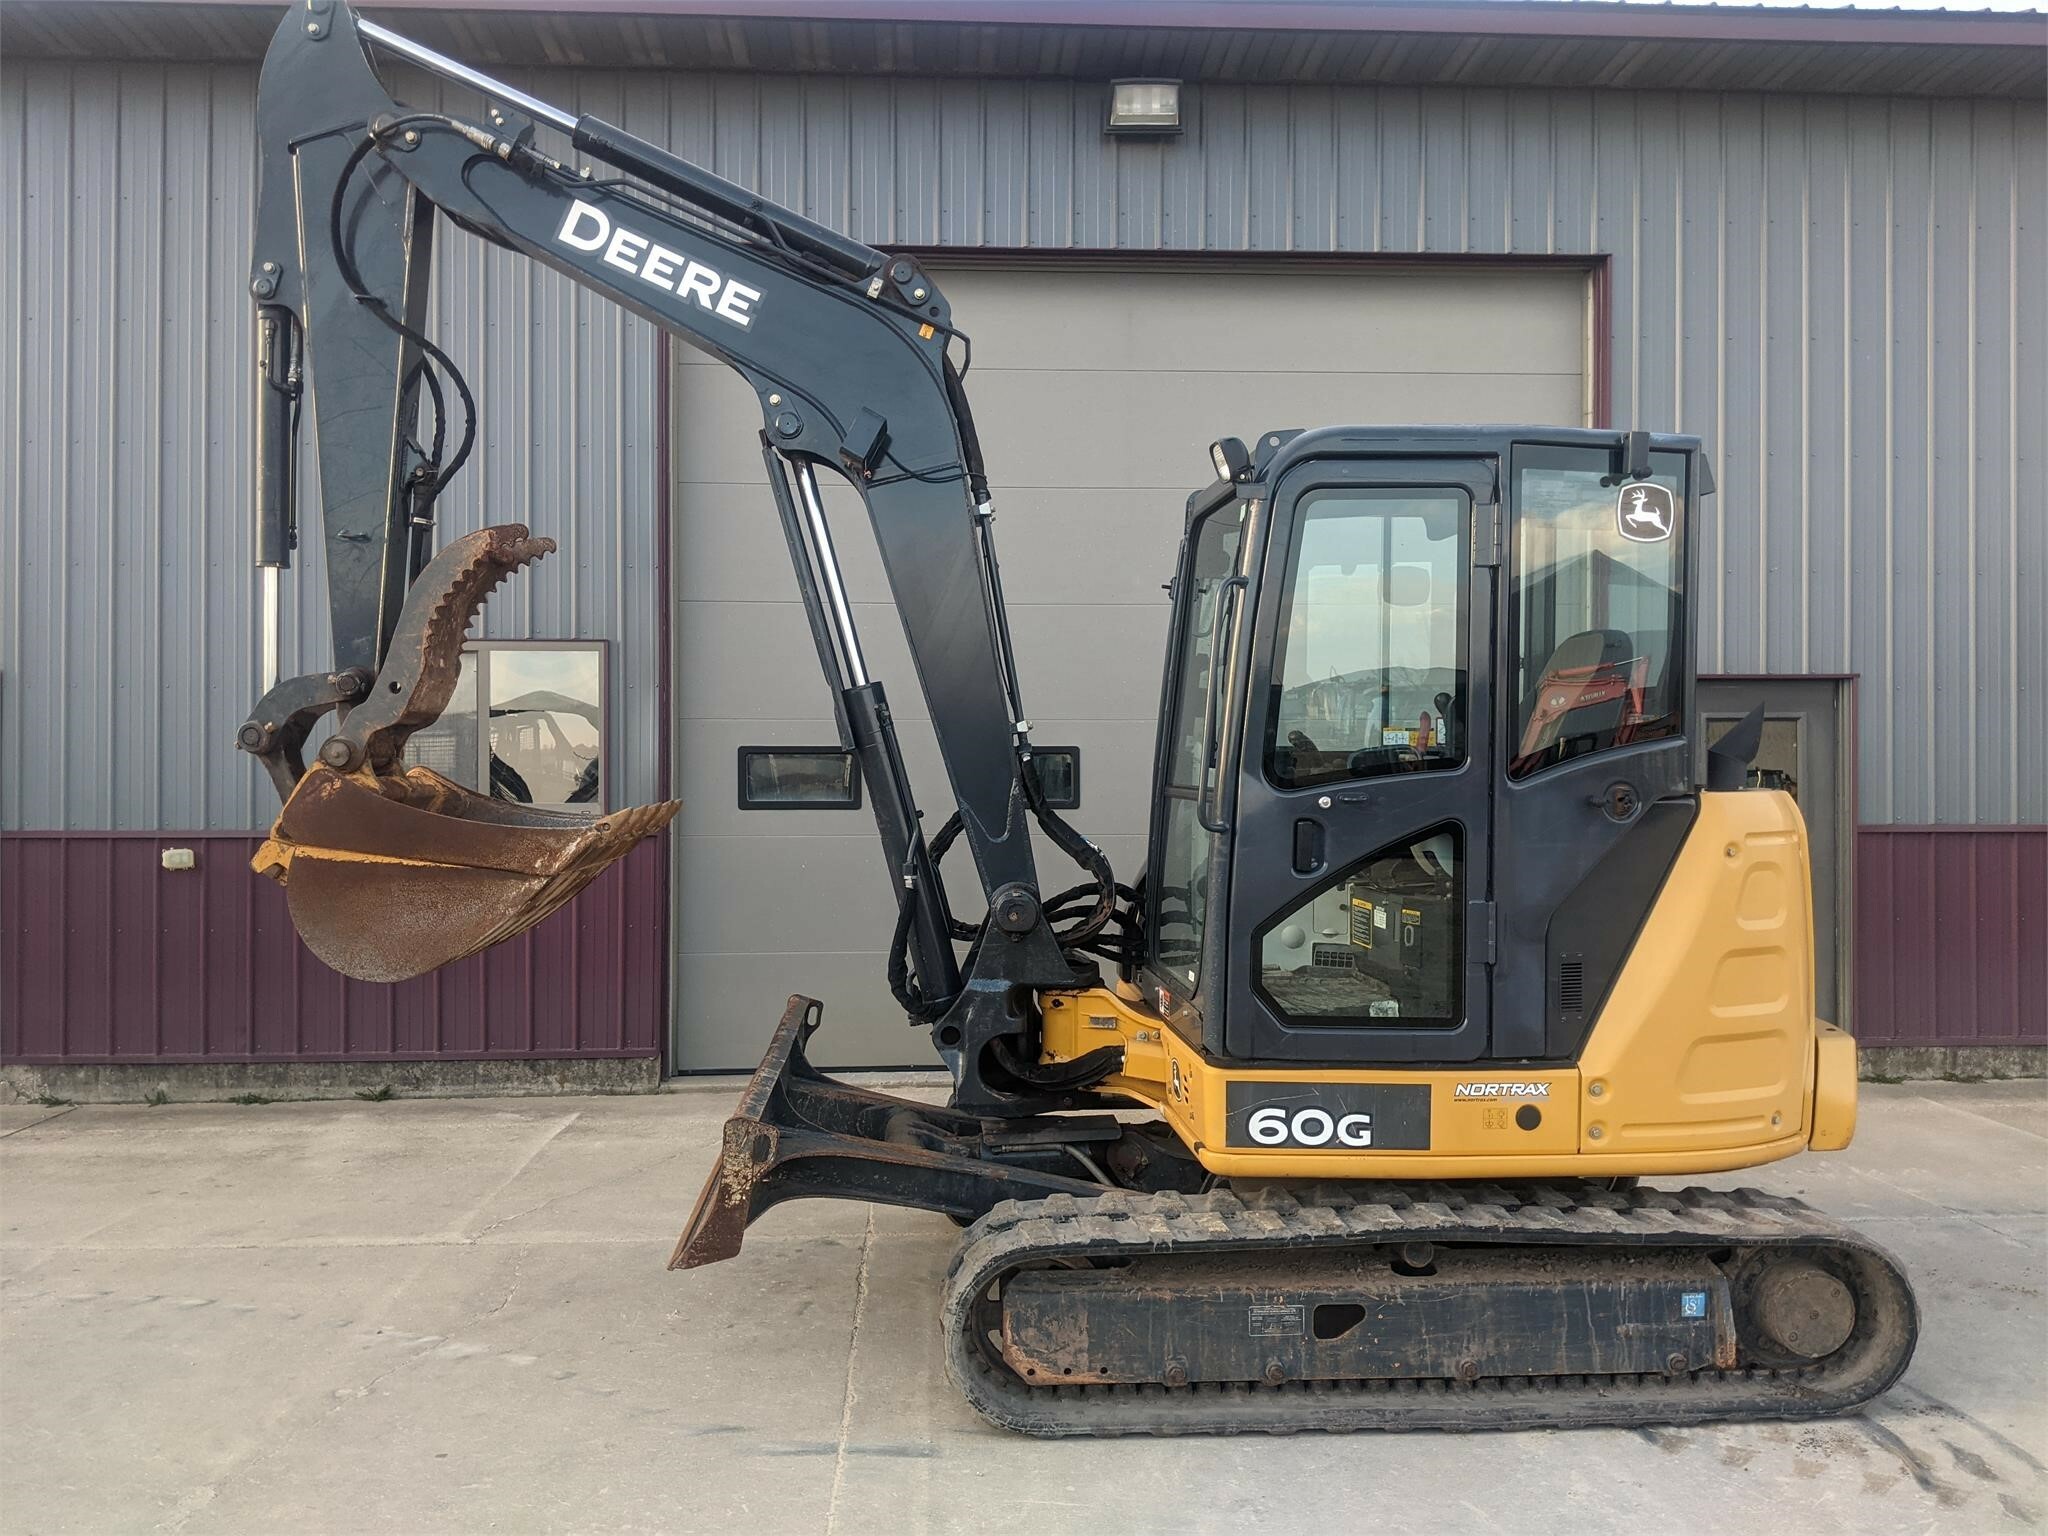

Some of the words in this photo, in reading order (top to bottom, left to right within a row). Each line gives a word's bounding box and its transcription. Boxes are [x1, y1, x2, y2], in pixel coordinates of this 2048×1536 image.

[558, 199, 761, 326] DEERE
[1454, 1082, 1551, 1097] NORTRAX
[1248, 1108, 1372, 1147] 60G
